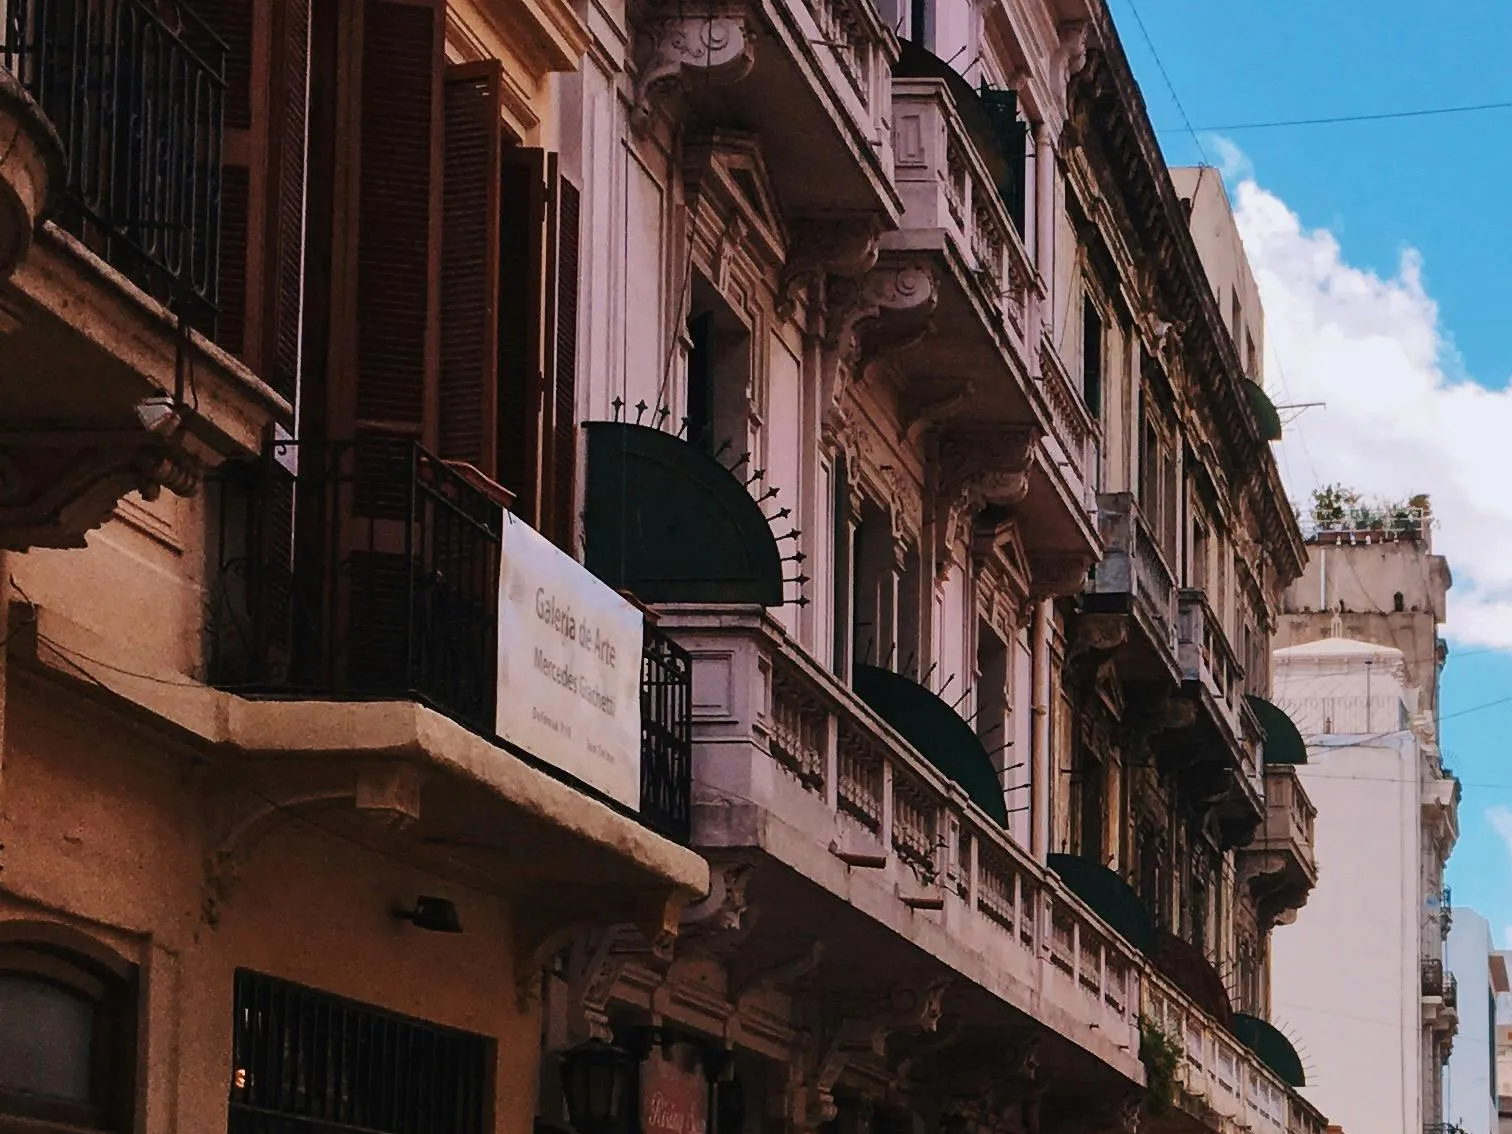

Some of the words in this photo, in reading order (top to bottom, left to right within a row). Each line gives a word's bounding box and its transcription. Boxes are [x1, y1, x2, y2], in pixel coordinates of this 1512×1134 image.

[535, 587, 576, 640] Galería
[579, 617, 592, 652] de
[593, 627, 616, 669] Arte
[532, 647, 577, 694] Mercedes
